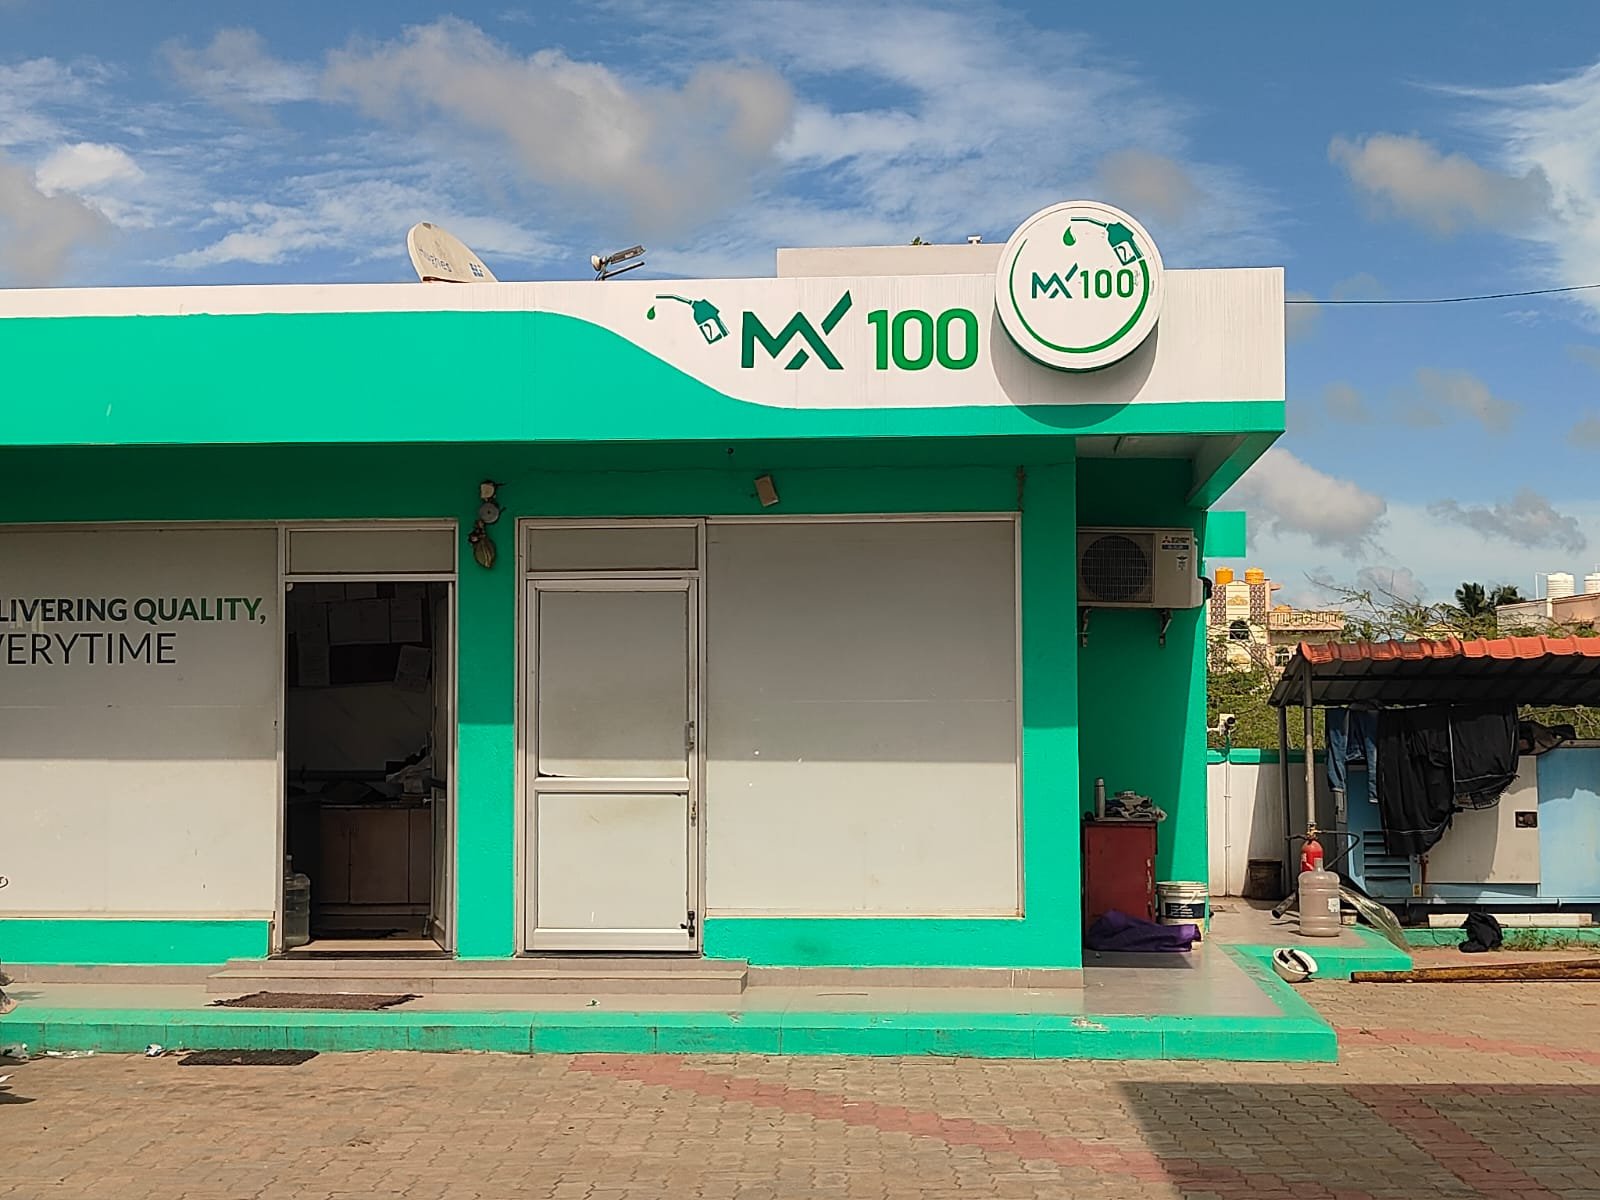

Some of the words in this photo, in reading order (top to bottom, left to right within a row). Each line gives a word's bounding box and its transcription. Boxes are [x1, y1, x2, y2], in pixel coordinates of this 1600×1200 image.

[1080, 269, 1134, 299] 100
[867, 307, 979, 371] 100
[133, 598, 266, 625] QUALITY,
[0, 632, 177, 665] ERYTIME
